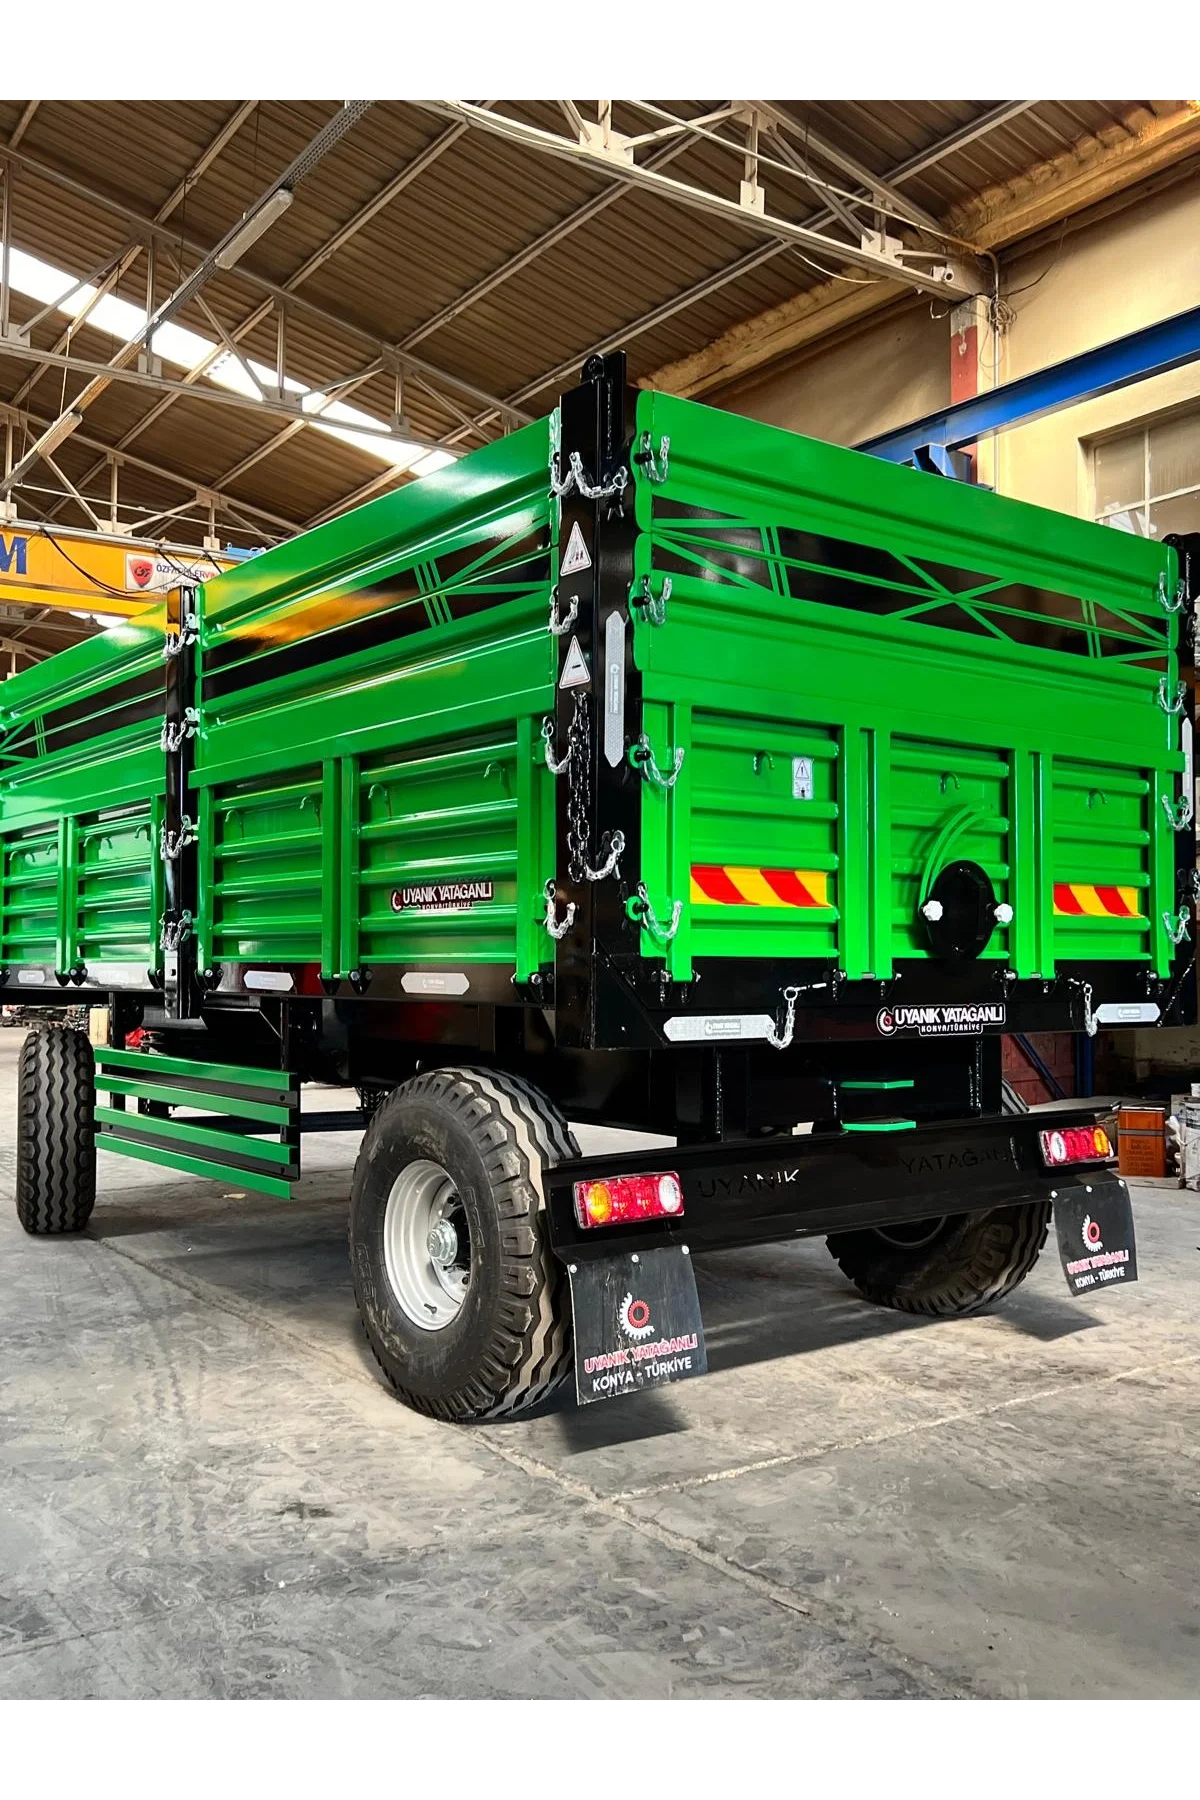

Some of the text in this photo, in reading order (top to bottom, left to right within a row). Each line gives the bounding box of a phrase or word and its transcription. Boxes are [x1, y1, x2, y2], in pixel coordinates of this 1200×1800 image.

[403, 886, 438, 904] UYANIK
[895, 1007, 941, 1025] UYANIK
[921, 1023, 981, 1033] KONYA/TÜRKİYE
[698, 1168, 800, 1198] UYANIK
[1075, 1274, 1095, 1288] KONYA
[1098, 1266, 1125, 1281] TÜRKİYE
[584, 1349, 631, 1374] UYANIK
[592, 1370, 634, 1392] KONYA
[644, 1356, 692, 1378] TÜRKİYE
